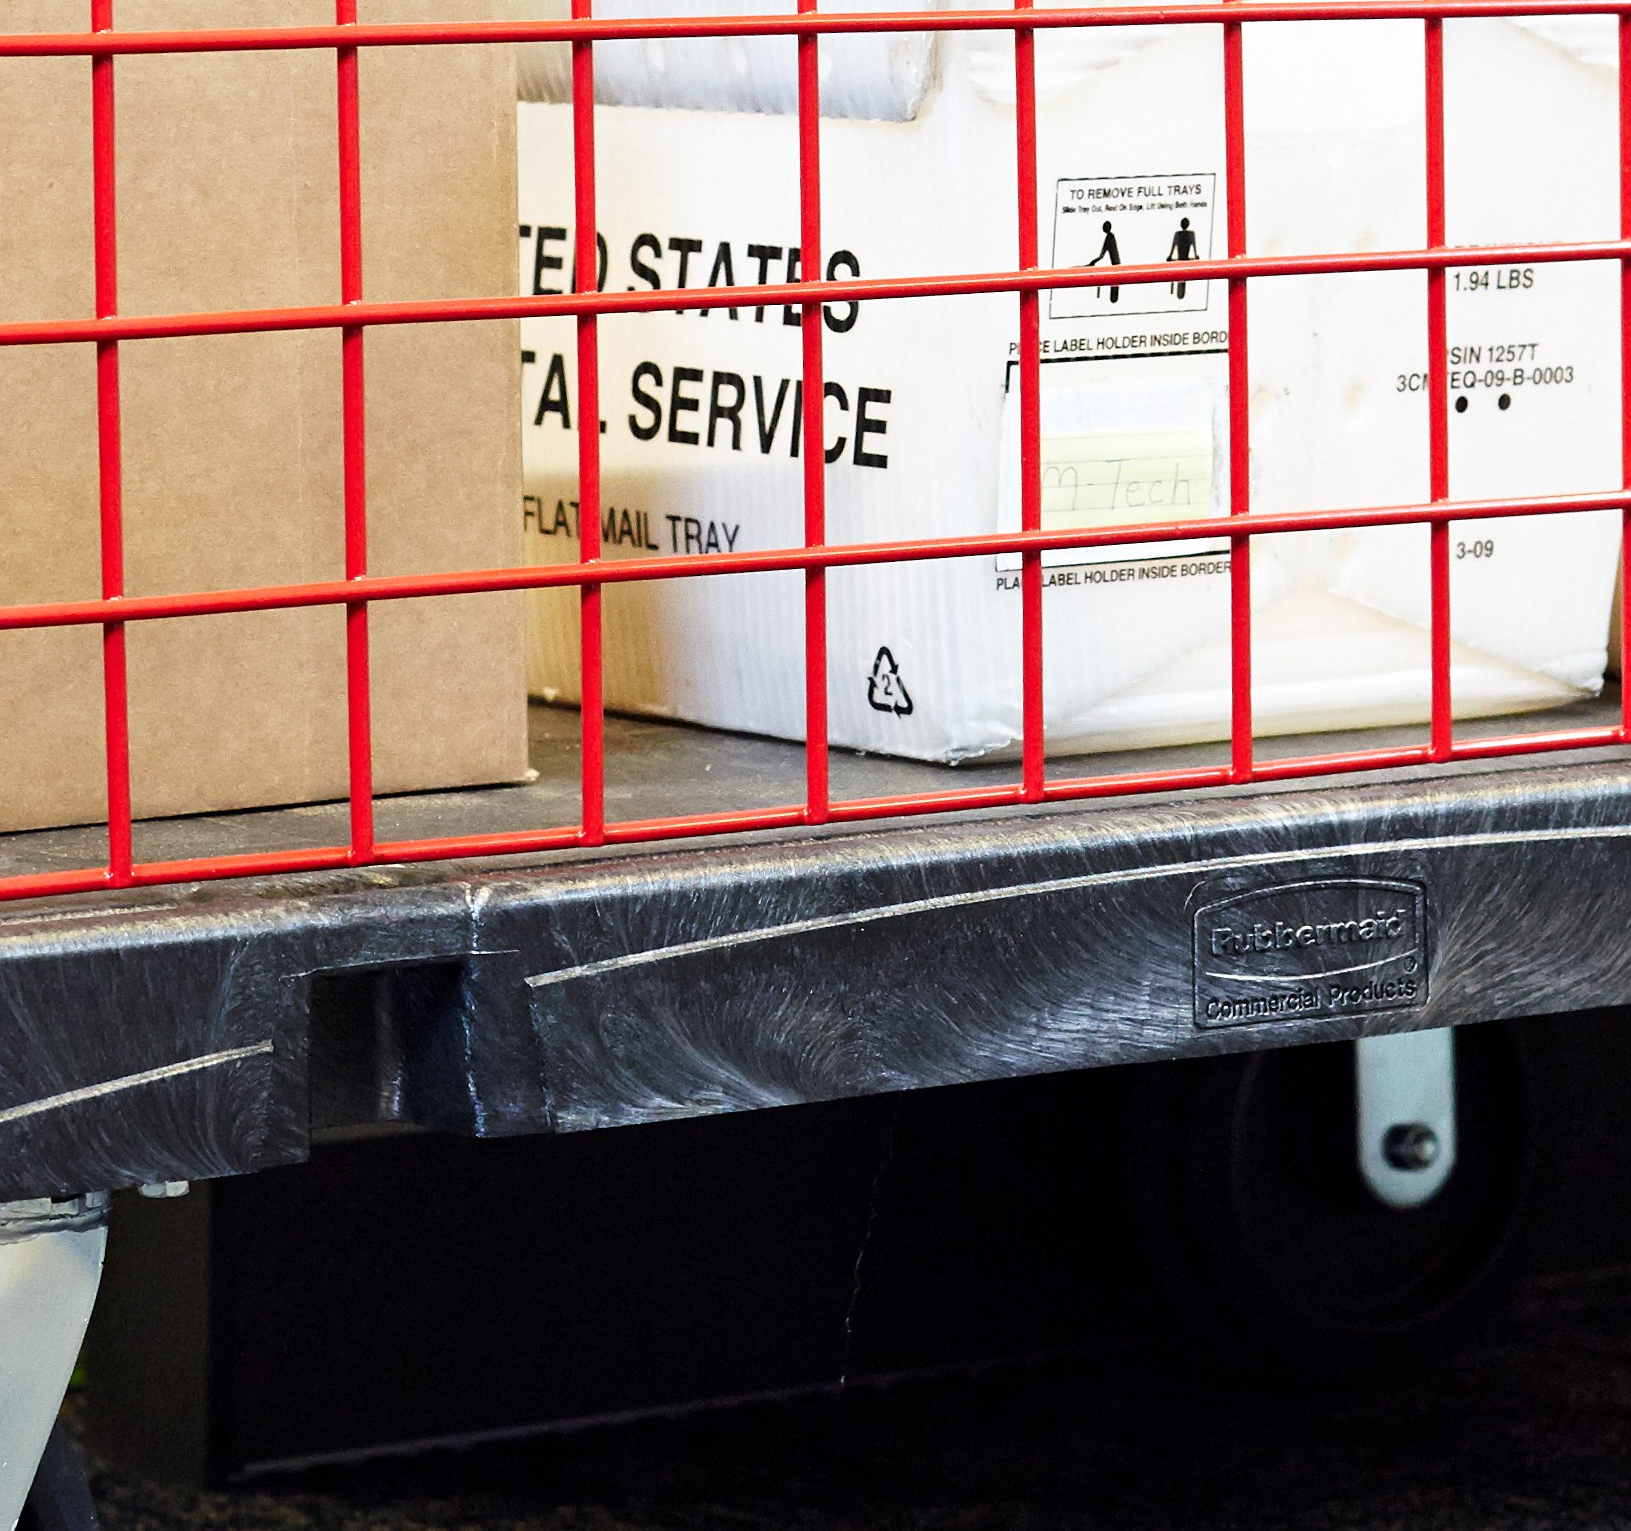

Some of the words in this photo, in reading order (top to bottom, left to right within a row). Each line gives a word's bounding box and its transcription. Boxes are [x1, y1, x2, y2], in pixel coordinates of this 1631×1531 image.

[1070, 189, 1085, 201] TO
[1087, 186, 1133, 200] REMOVE
[1137, 186, 1164, 198] FULL
[1168, 183, 1202, 196] TRAYS
[1453, 270, 1490, 291] 1.94
[1497, 268, 1534, 289] LBS
[1054, 337, 1093, 353] LABEL
[1096, 334, 1147, 351] HOLDER
[1150, 331, 1189, 347] INSIDE
[1192, 330, 1228, 345] BORD
[1488, 343, 1538, 363] 1257T
[629, 361, 891, 469] SERVICE
[600, 506, 659, 550] MAIL
[665, 514, 740, 554] TRAY
[1042, 571, 1081, 588] LABEL
[1084, 568, 1135, 585] HOLDER
[1138, 564, 1177, 580] INSIDE
[1180, 561, 1231, 577] BORDER
[1211, 909, 1407, 956] Rubbermaid
[1206, 986, 1321, 1021] Commercial
[1328, 977, 1418, 1009] Products
